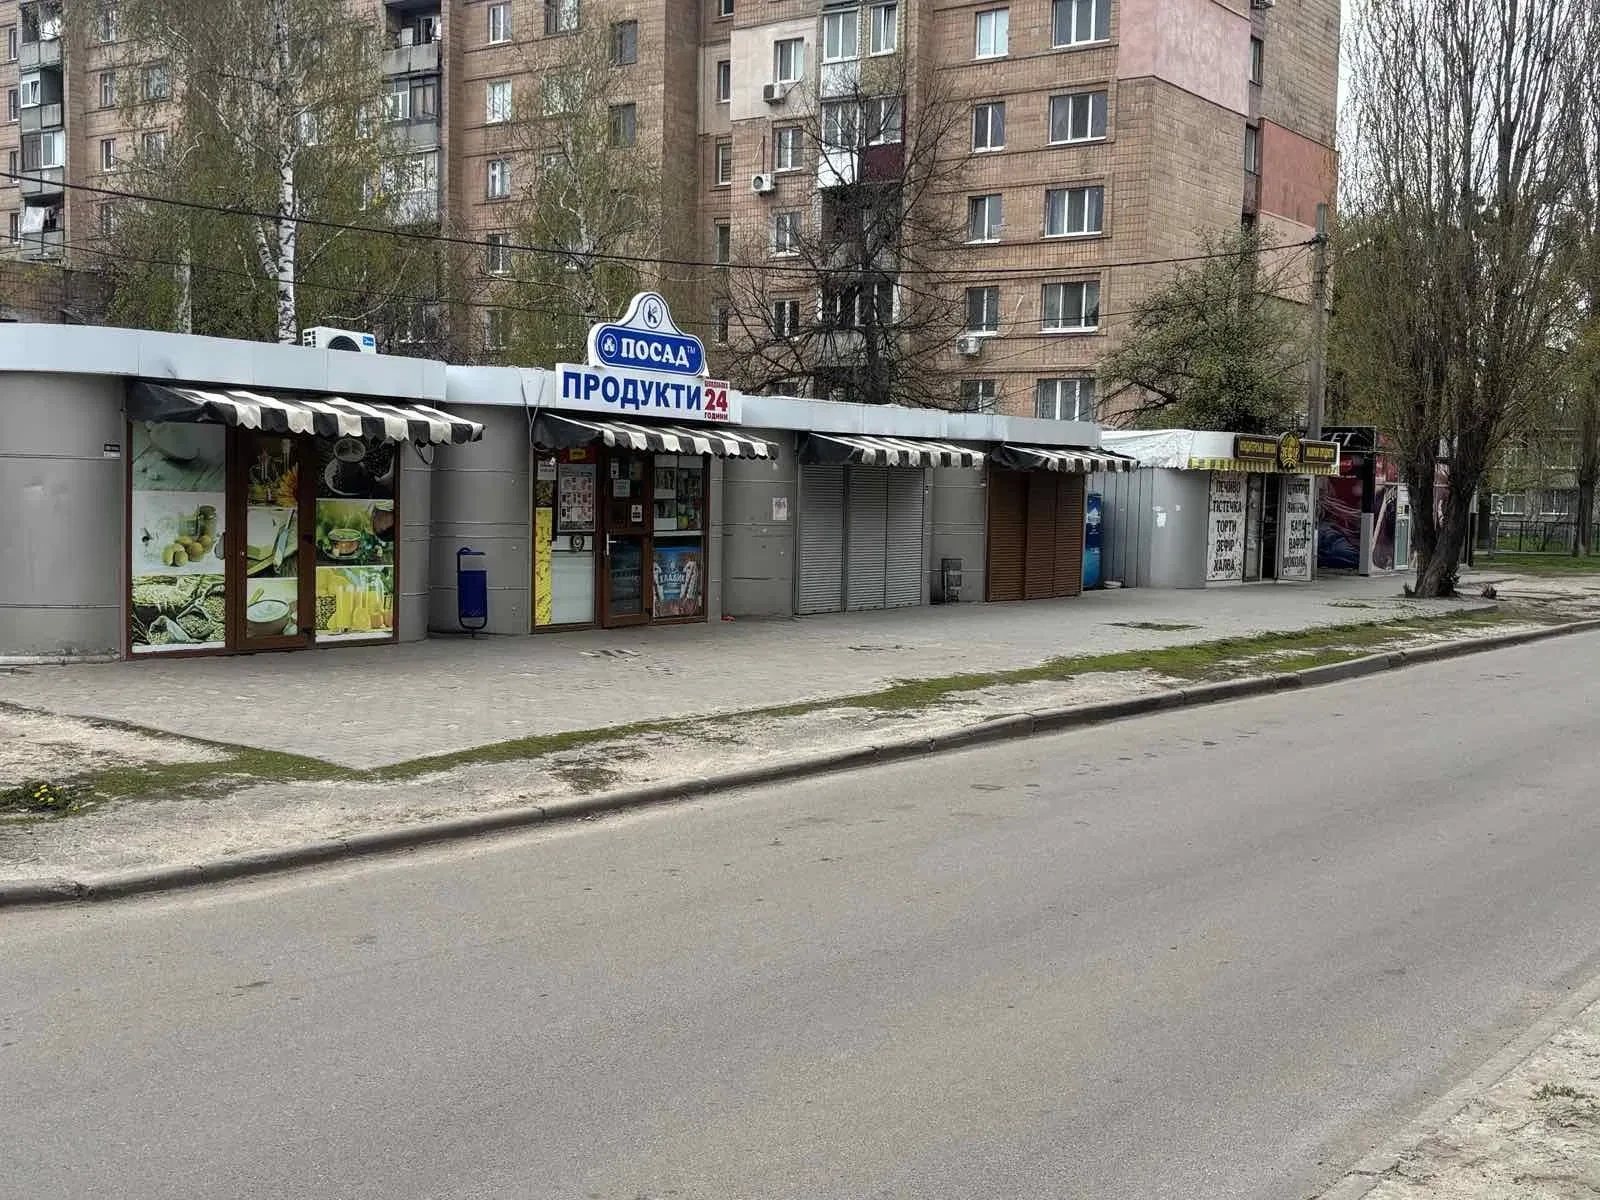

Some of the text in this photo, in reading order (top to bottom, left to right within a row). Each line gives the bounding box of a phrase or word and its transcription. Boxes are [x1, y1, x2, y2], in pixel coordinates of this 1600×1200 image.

[620, 337, 689, 368] ПОСАД
[562, 371, 702, 411] ПРОДУКТИ
[704, 388, 728, 412] 24
[704, 412, 728, 421] ГОДИНИ
[1212, 500, 1242, 513] ТІСТЕЧКА
[1216, 520, 1237, 533] ТОРТИ
[1216, 540, 1235, 553] ЗЕФІР
[1213, 559, 1235, 572] ХАЛВА
